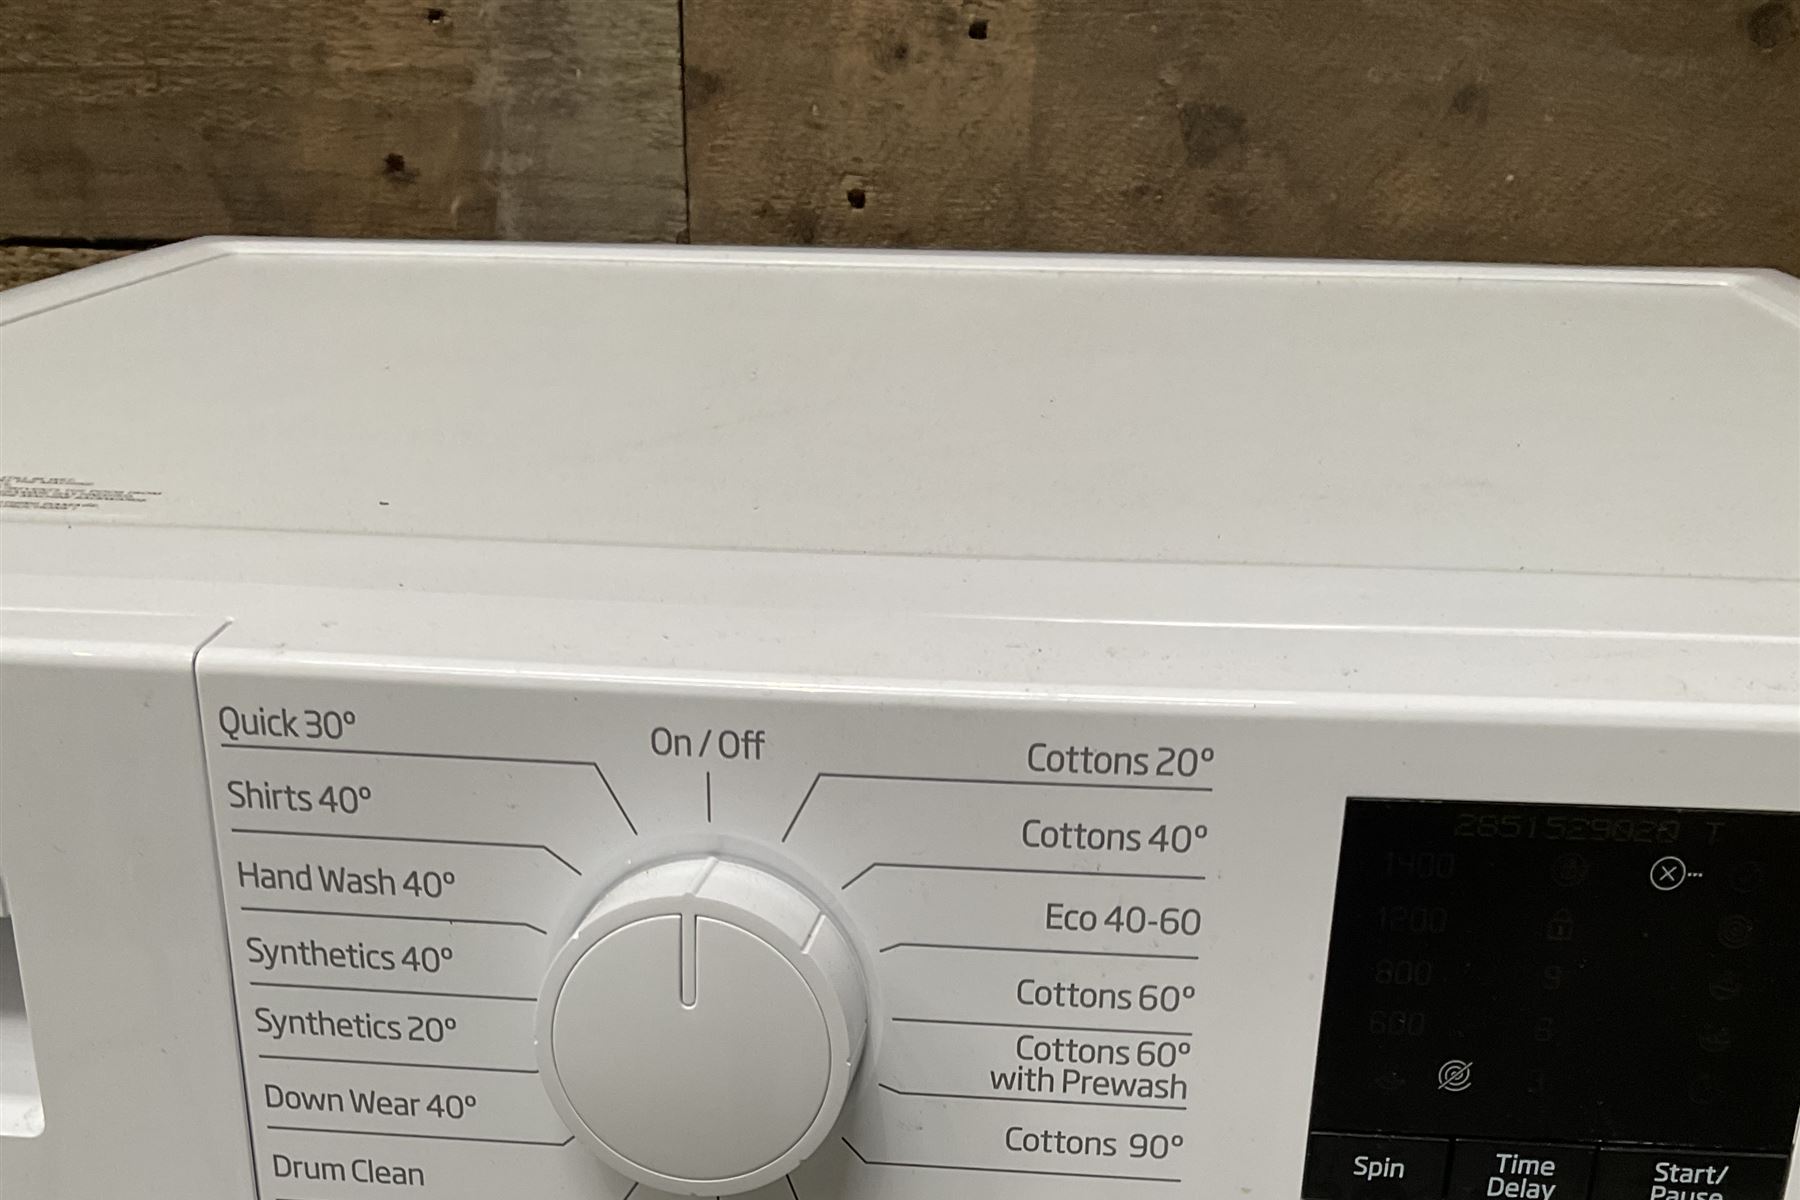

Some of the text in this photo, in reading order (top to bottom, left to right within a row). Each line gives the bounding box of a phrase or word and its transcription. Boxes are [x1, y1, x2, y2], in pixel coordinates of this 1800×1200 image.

[218, 705, 300, 741] Quick
[650, 726, 692, 757] On
[718, 729, 766, 761] Off
[1027, 742, 1149, 776] Cottons
[227, 780, 313, 812] Shirts
[1022, 819, 1141, 852] Cottons
[237, 860, 313, 892] Hand
[317, 865, 396, 896] Wash
[1046, 902, 1202, 936] Eco 40-60
[246, 936, 396, 971] Synthetics
[1017, 978, 1132, 1010] Cottons
[254, 1007, 402, 1041] Synthetics
[1016, 1034, 1130, 1066] Cottons
[990, 1065, 1187, 1100] with Prewash
[264, 1083, 344, 1113] Down
[348, 1088, 421, 1117] Wear
[1005, 1126, 1117, 1157] Cottons
[272, 1153, 425, 1187] Drum Clean
[1352, 1154, 1406, 1182] Spin
[1495, 1153, 1556, 1177] Time
[1653, 1161, 1730, 1185] Start/
